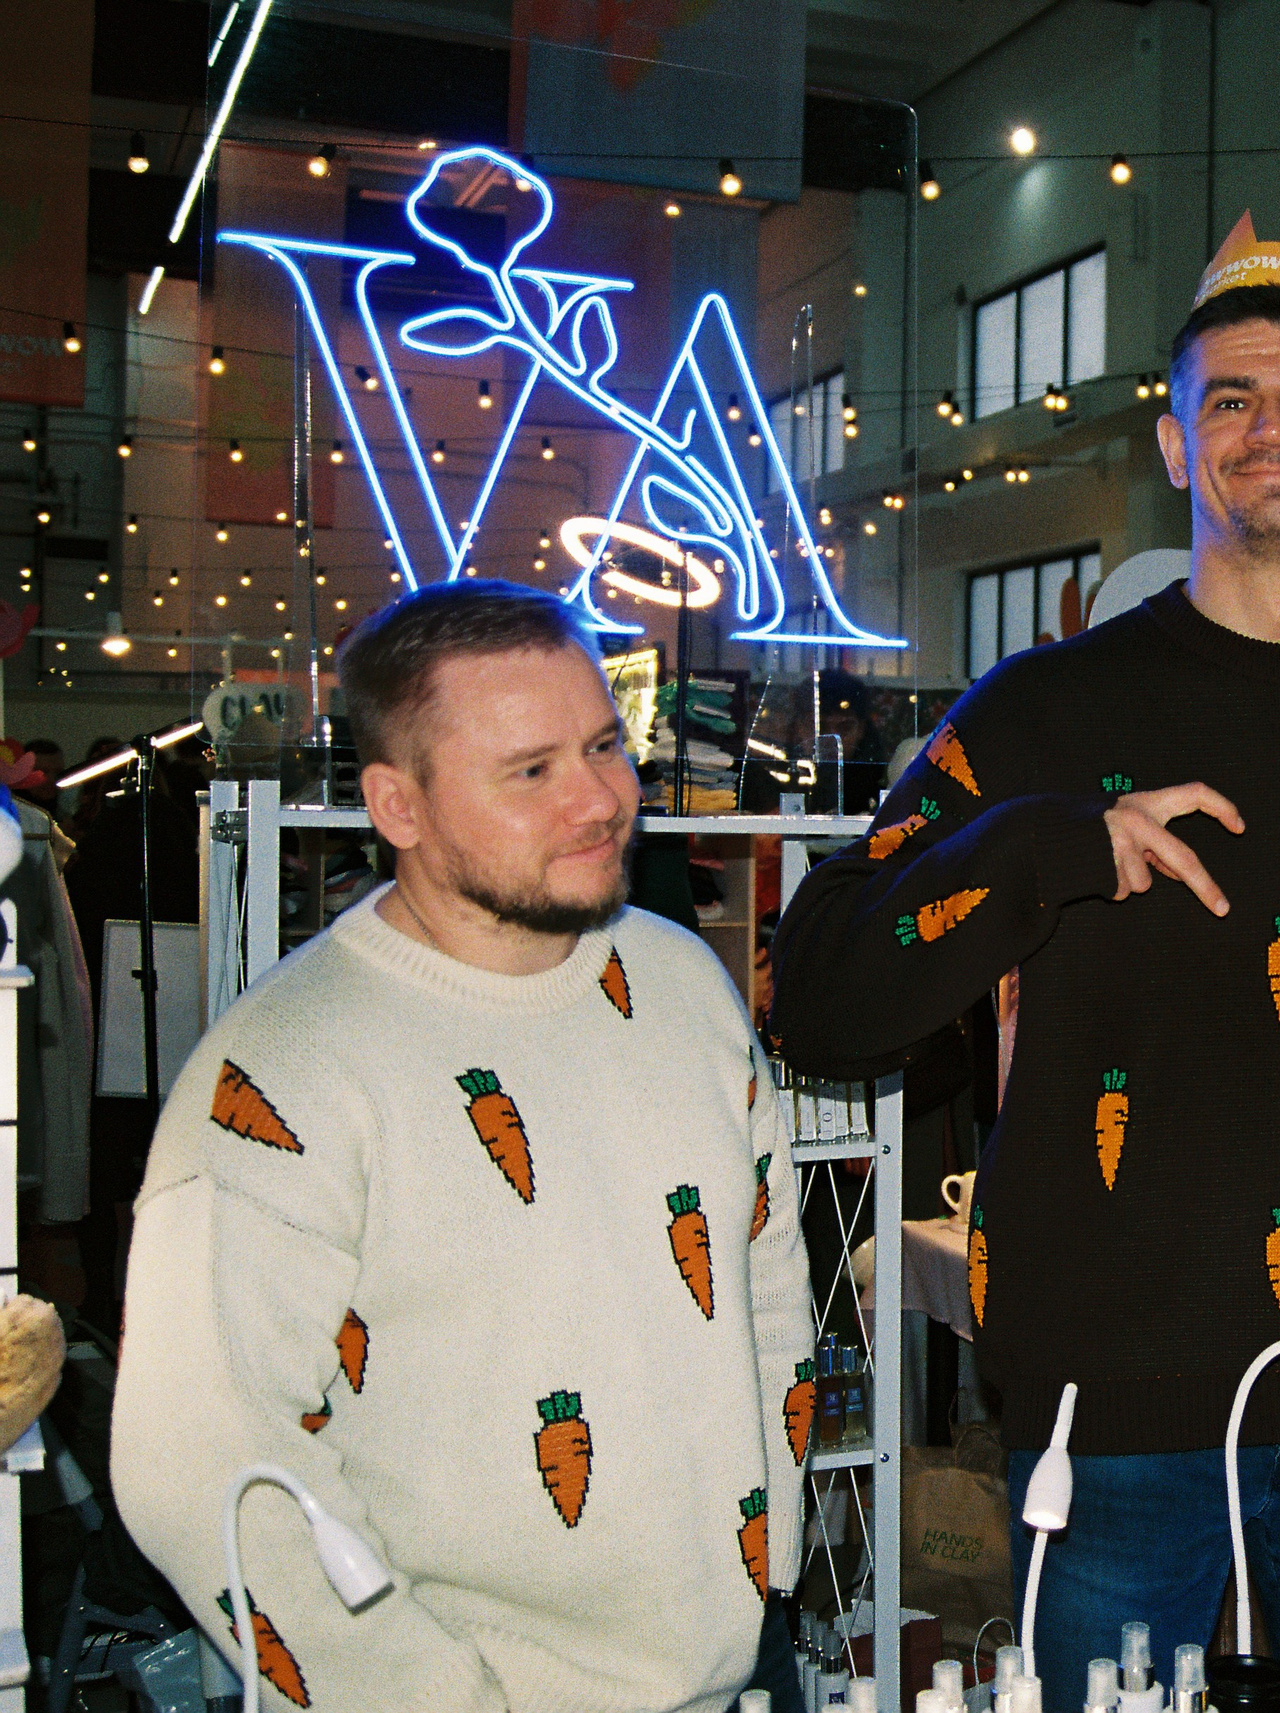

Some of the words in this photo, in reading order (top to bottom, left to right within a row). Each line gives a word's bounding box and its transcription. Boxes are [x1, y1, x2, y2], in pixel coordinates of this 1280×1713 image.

[924, 1528, 984, 1549] HANDS
[920, 1540, 938, 1555] IN
[941, 1545, 980, 1562] CLAY
